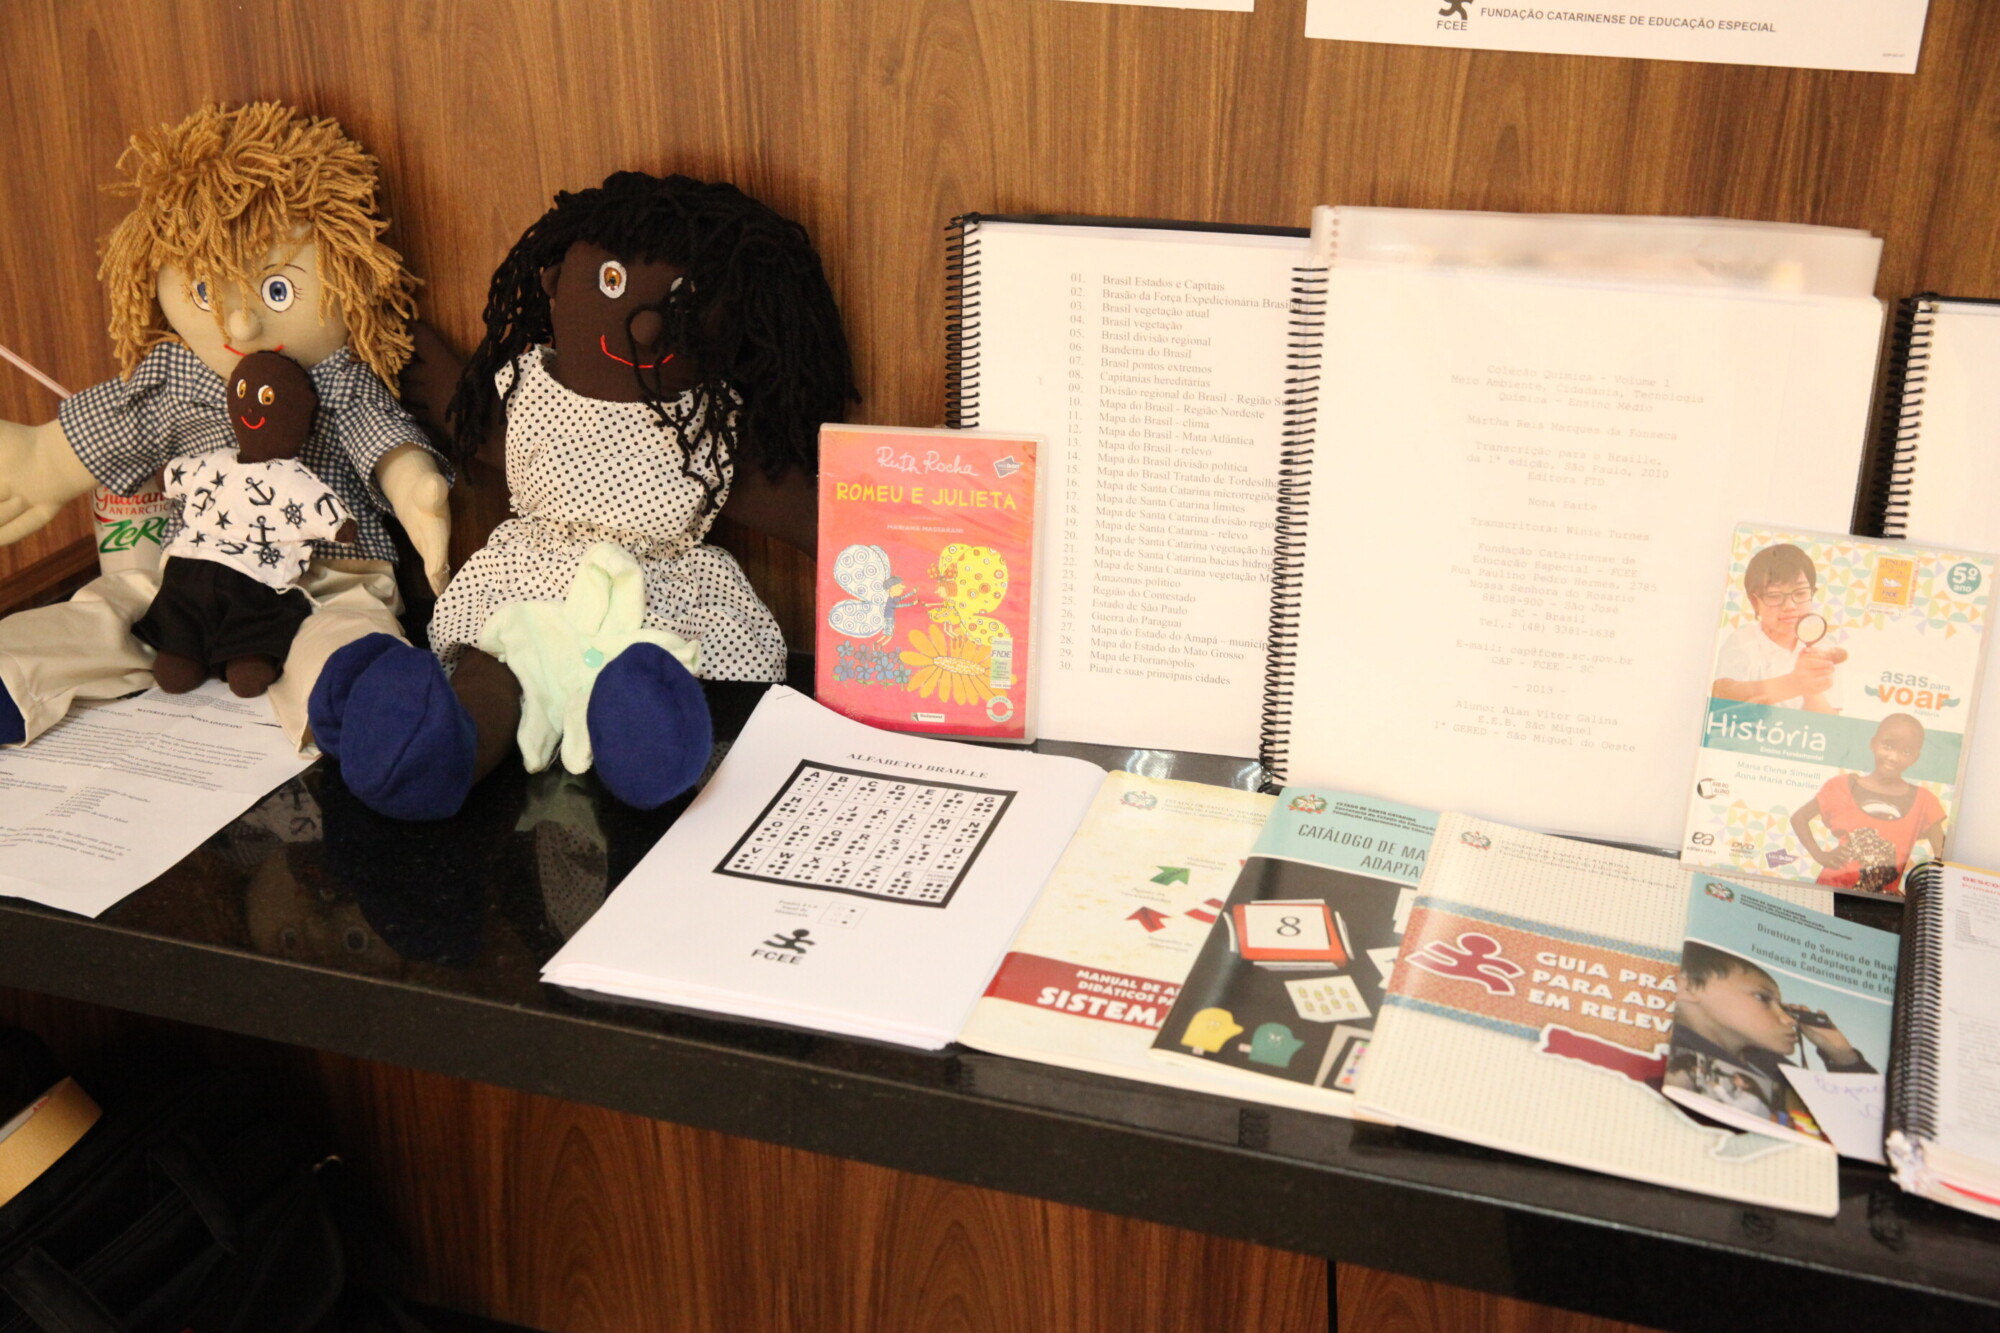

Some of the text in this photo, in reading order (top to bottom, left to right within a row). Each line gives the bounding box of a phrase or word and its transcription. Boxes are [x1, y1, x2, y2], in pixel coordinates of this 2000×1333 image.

[1437, 20, 1467, 30] FCEE
[1481, 8, 1776, 32] FUNDAÇÃO CATARINENSE DE EDUCAÇÃO ESPECIAL
[1071, 273, 1084, 282] 01.
[1103, 276, 1131, 285] Brasil
[1135, 278, 1172, 287] Estados
[1184, 280, 1224, 291] Capitais
[1070, 287, 1084, 296] 02.
[1103, 289, 1136, 299] Brasão
[1139, 291, 1150, 300] da
[1154, 292, 1181, 303] Força
[1185, 295, 1259, 306] Expedicionária
[1070, 301, 1209, 318] 03. Brasil vegetação atual
[1070, 329, 1210, 346] 05. Brasil divisão regional
[1102, 345, 1144, 355] Bandeira
[1148, 347, 1160, 356] do
[1163, 348, 1191, 358] Brasil
[1101, 358, 1129, 368] Brasil
[1468, 416, 1509, 426] Martha
[1630, 429, 1677, 440] Fonseca
[877, 447, 979, 476] Ruth Rocha
[837, 482, 1016, 510] ROMEU E JULIETA
[1528, 498, 1555, 507] Nona
[109, 500, 176, 514] ANTARCTICA
[1478, 544, 1532, 555] Fundação
[1539, 550, 1615, 562] Catarinense
[1451, 566, 1470, 574] Rua
[1479, 569, 1526, 580] Paulino
[1534, 574, 1567, 584] Pedro
[1953, 566, 1977, 583] 5º
[1954, 584, 1972, 592] ano
[1061, 609, 1181, 628] 26. Guerra do Paraguai
[1059, 661, 1072, 670] 30.
[1147, 671, 1192, 681] principais
[1195, 675, 1230, 684] cidades
[1881, 670, 1950, 691] asas para
[1878, 684, 1950, 710] voar
[1707, 712, 1826, 751] História
[1760, 746, 1824, 760] Ensino Fundamental
[846, 753, 989, 778] ALFABETO BRAILLE
[1737, 760, 1760, 770] Maria
[1763, 765, 1787, 775] Elena
[1735, 772, 1756, 781] Anna
[1759, 775, 1782, 785] Maria
[1299, 824, 1425, 861] CATÁLOGO DE MA
[1360, 855, 1424, 879] ADAPTA
[1962, 876, 2000, 888] DESCO
[1277, 916, 1301, 937] 8
[1757, 922, 1801, 946] Diretrizes
[1804, 939, 1817, 950] do
[1819, 943, 1855, 963] Serviço
[1858, 956, 1870, 966] de
[751, 949, 803, 965] FCEE
[1752, 944, 1797, 968] Fundação
[1800, 961, 1859, 986] Catarinense
[1862, 978, 1874, 990] de
[1810, 952, 1863, 976] Adaptação
[1866, 968, 1878, 980] de
[1536, 952, 1677, 992] GUIA PRÁ
[1076, 970, 1181, 996] MANUAL DE A
[1078, 981, 1156, 1002] DIDÁTICOS
[1532, 970, 1612, 999] PARA
[1528, 990, 1673, 1032] EM RELEV
